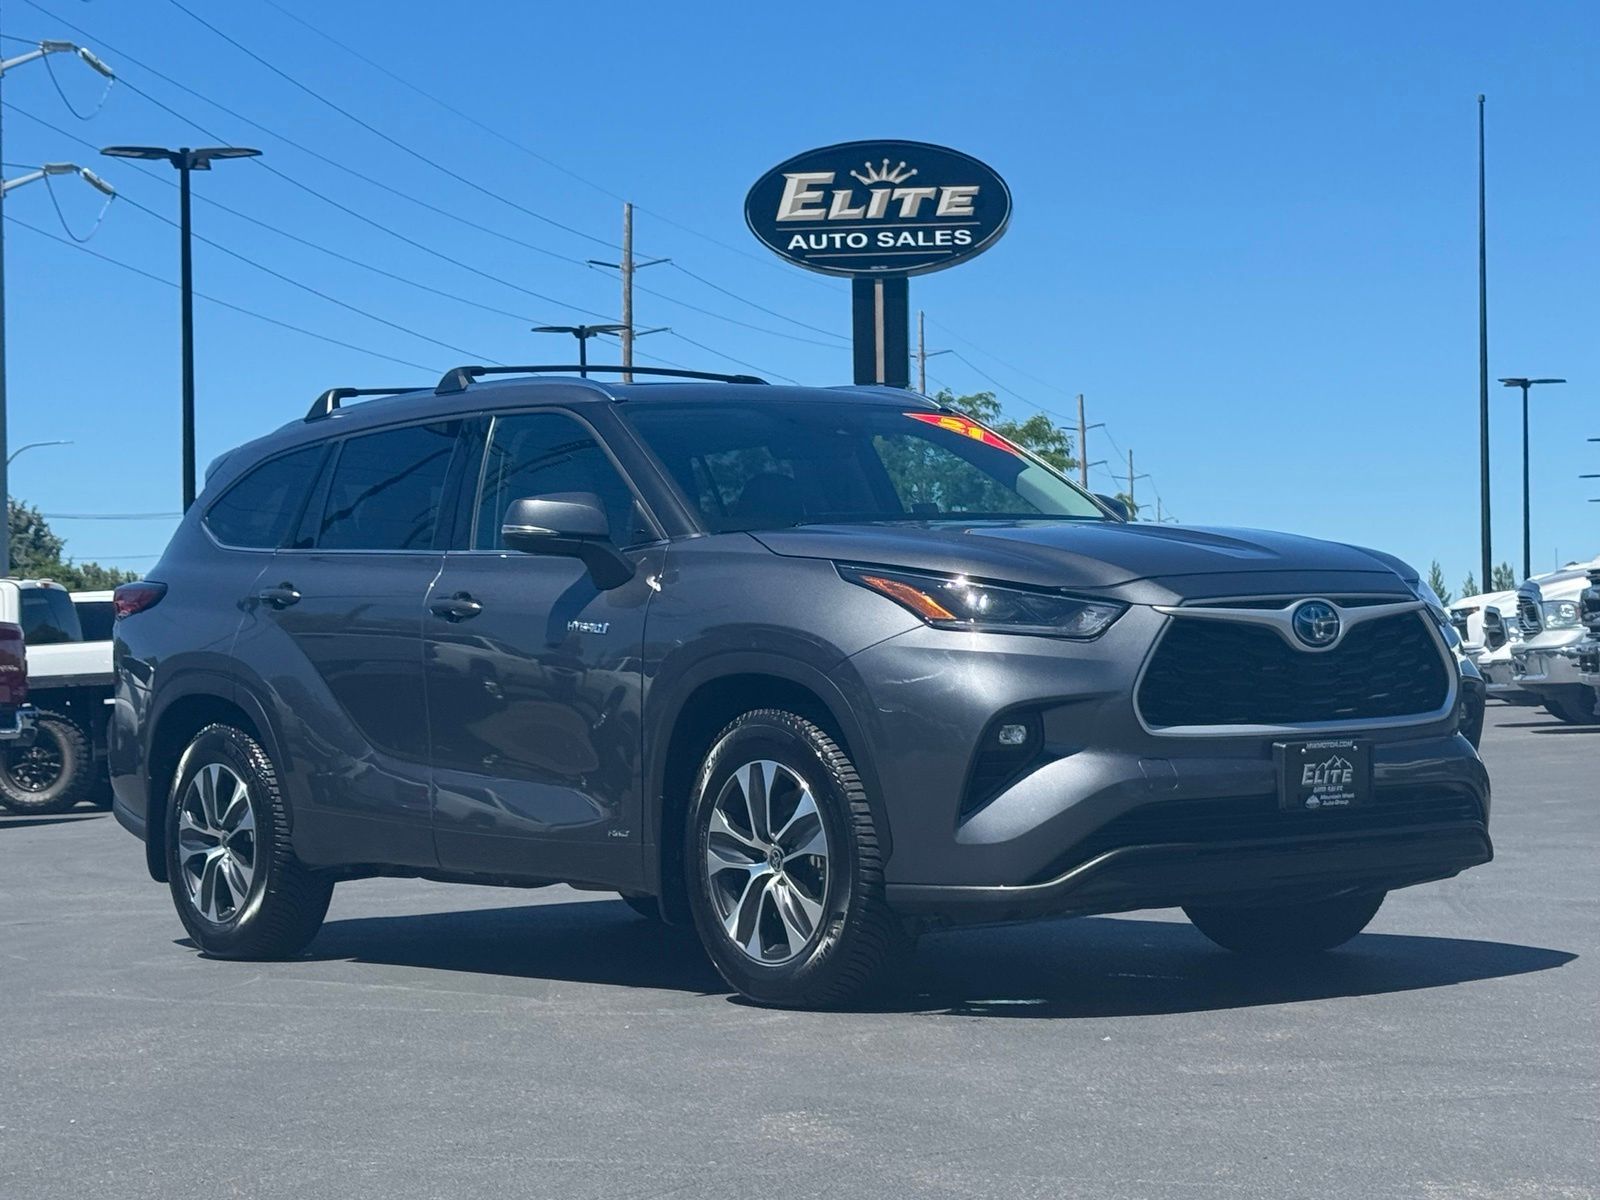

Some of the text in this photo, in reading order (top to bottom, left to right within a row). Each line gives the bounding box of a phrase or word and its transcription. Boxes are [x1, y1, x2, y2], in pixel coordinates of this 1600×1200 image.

[776, 172, 981, 222] ELITE
[787, 229, 973, 250] AUTO SALES
[1301, 763, 1353, 785] ELITE
